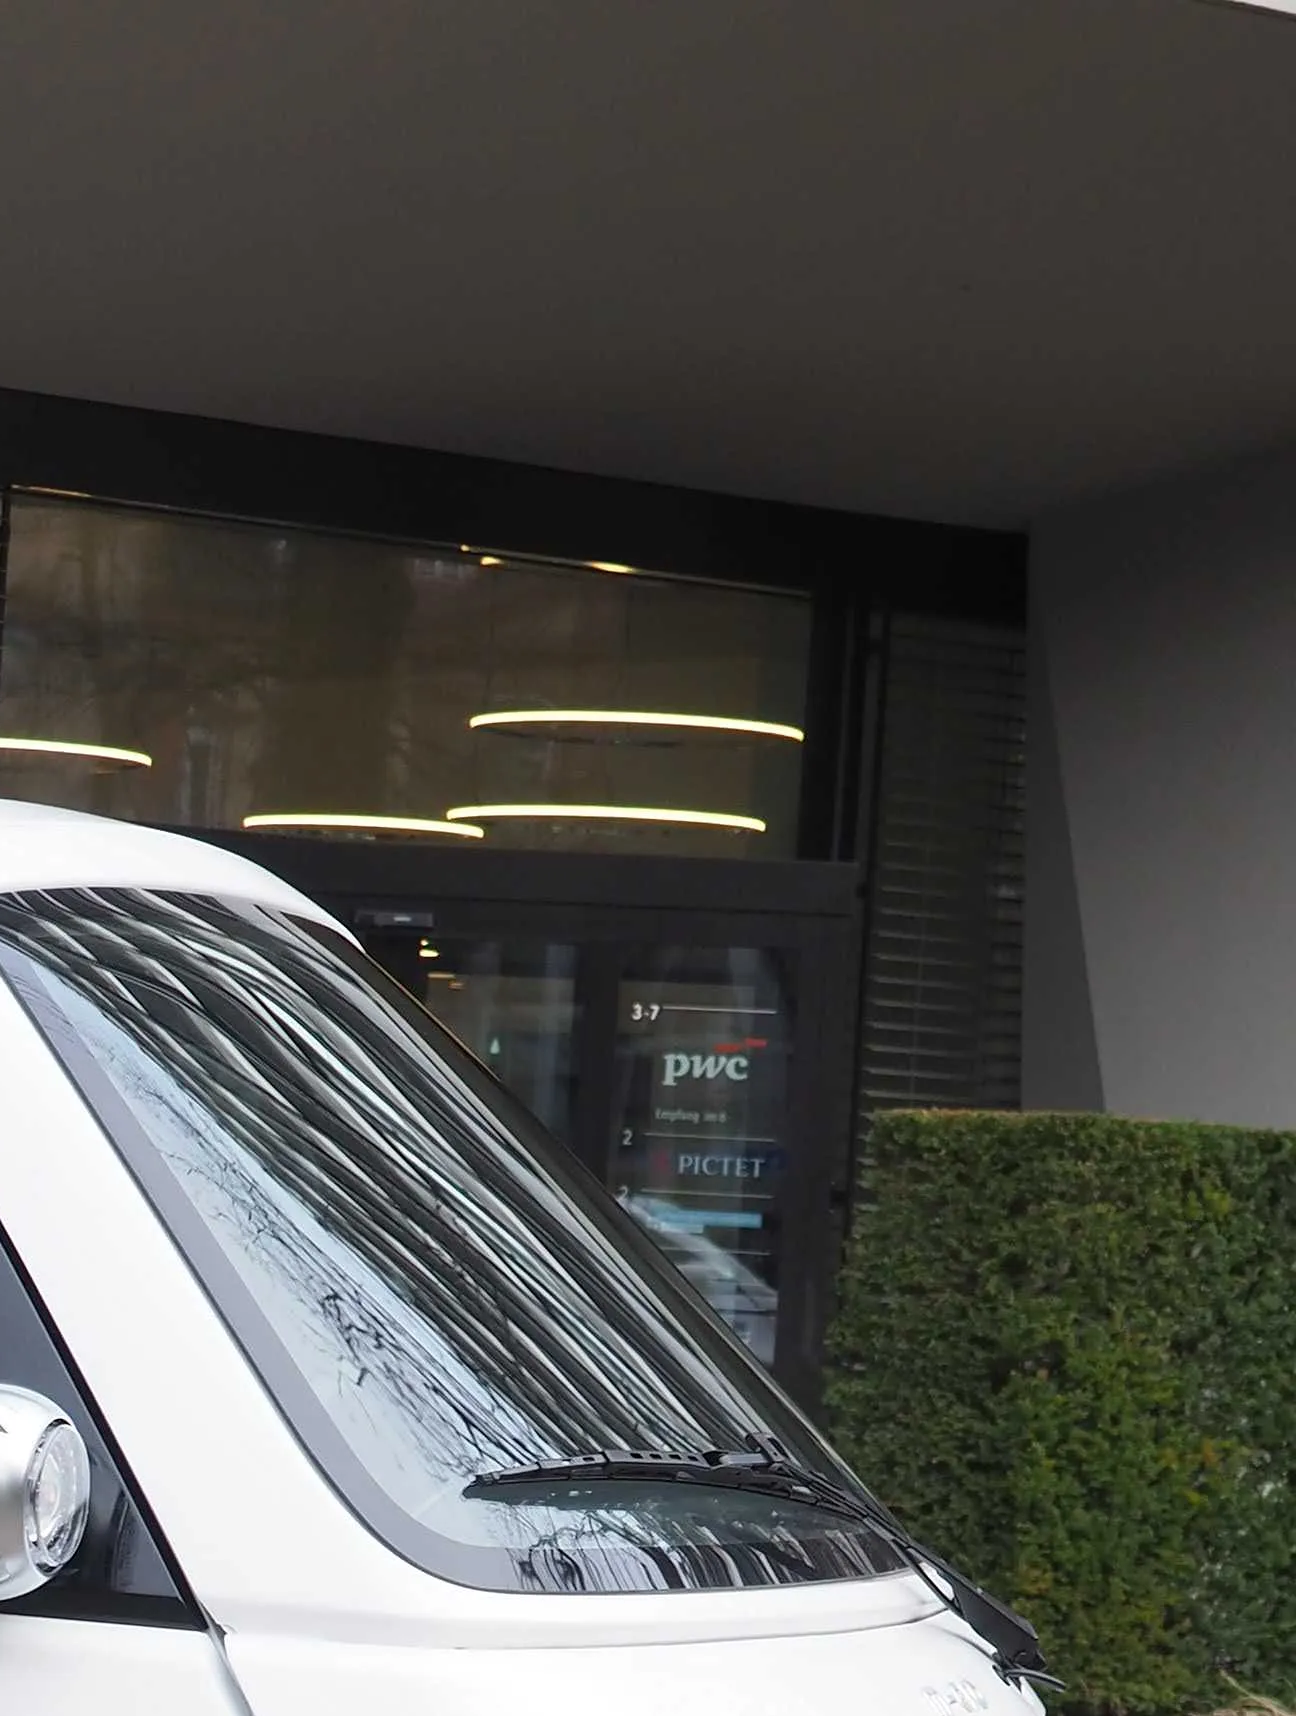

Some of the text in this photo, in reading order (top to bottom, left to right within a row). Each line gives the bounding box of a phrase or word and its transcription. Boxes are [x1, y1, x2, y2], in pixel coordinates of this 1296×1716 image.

[631, 1003, 661, 1021] 3-7
[662, 1053, 749, 1086] pwc
[622, 1129, 634, 1146] 2
[678, 1154, 766, 1178] PICTET
